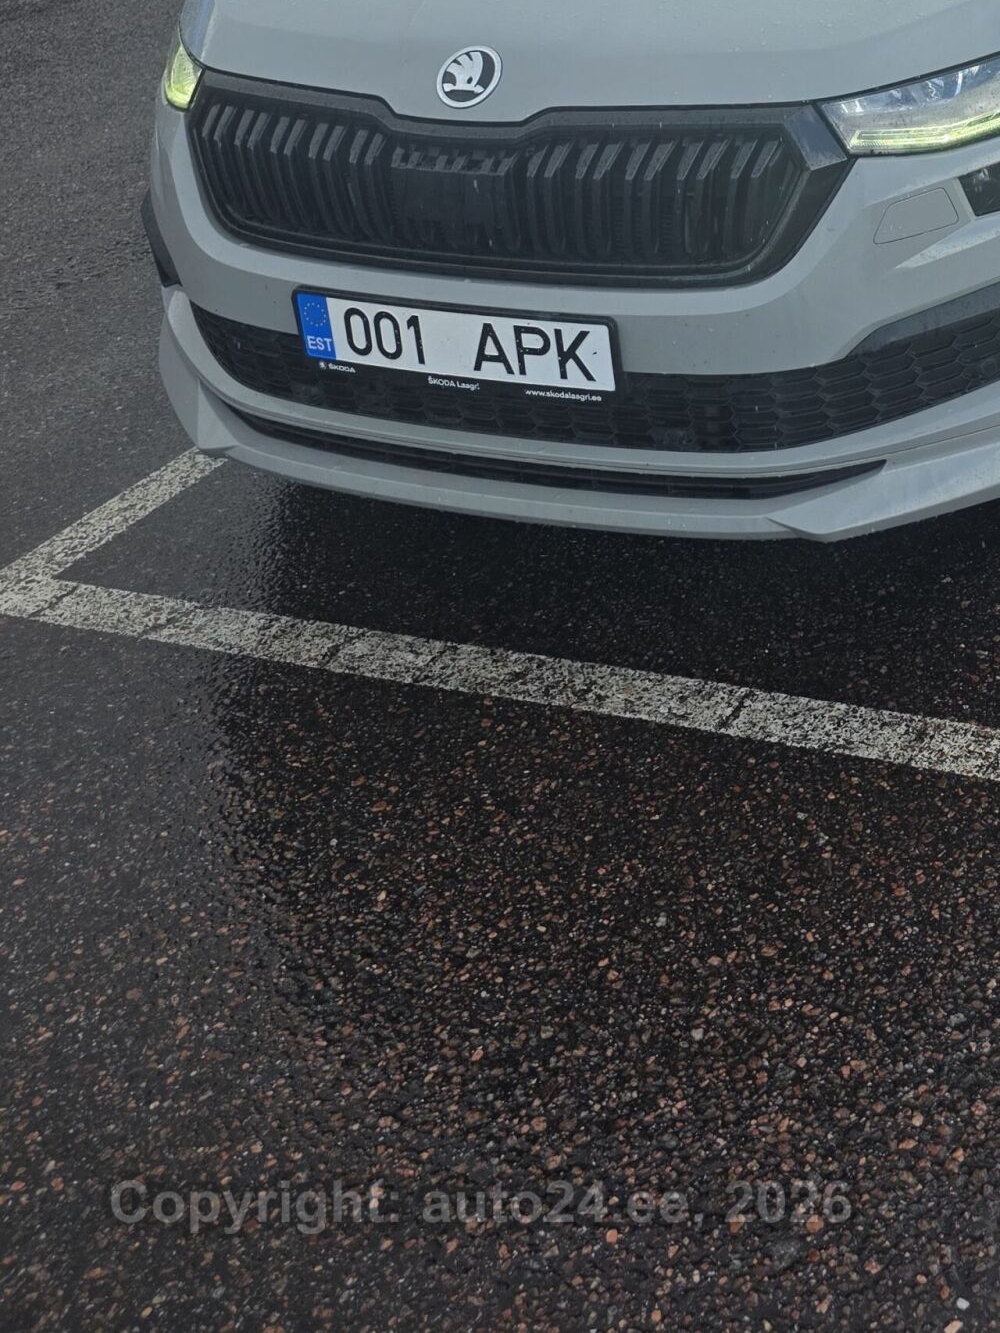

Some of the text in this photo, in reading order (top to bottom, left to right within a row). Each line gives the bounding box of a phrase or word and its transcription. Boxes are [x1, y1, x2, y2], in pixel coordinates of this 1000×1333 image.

[307, 335, 332, 351] EST
[343, 307, 596, 382] 001 APK
[427, 376, 456, 388] ŠKODA
[524, 389, 602, 402] www.skodalaagri.ee
